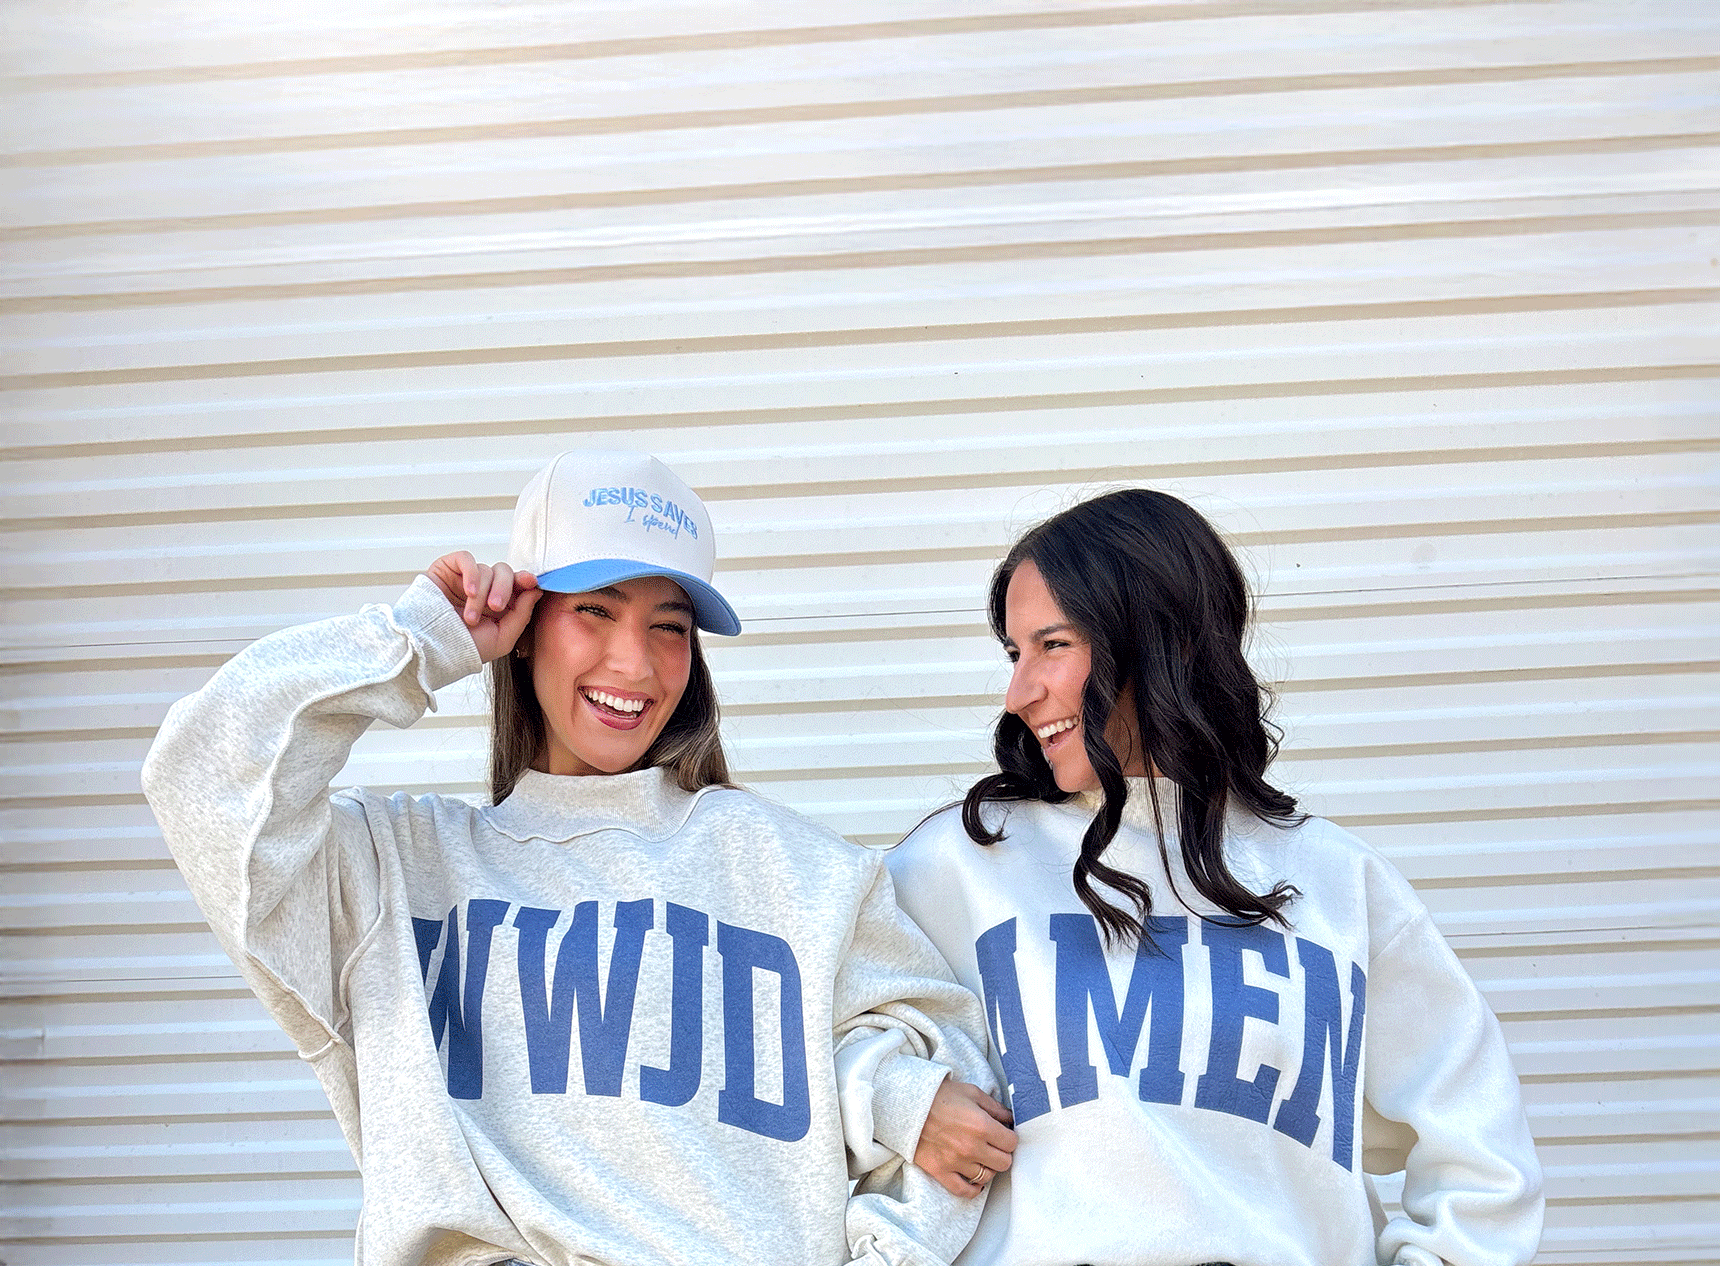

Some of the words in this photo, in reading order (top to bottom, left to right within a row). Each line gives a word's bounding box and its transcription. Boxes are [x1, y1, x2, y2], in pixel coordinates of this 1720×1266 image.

[583, 487, 648, 508] JESUS
[650, 494, 698, 540] SAVES
[624, 505, 638, 523] I
[412, 898, 811, 1142] WWJD
[975, 913, 1366, 1172] AMEN
